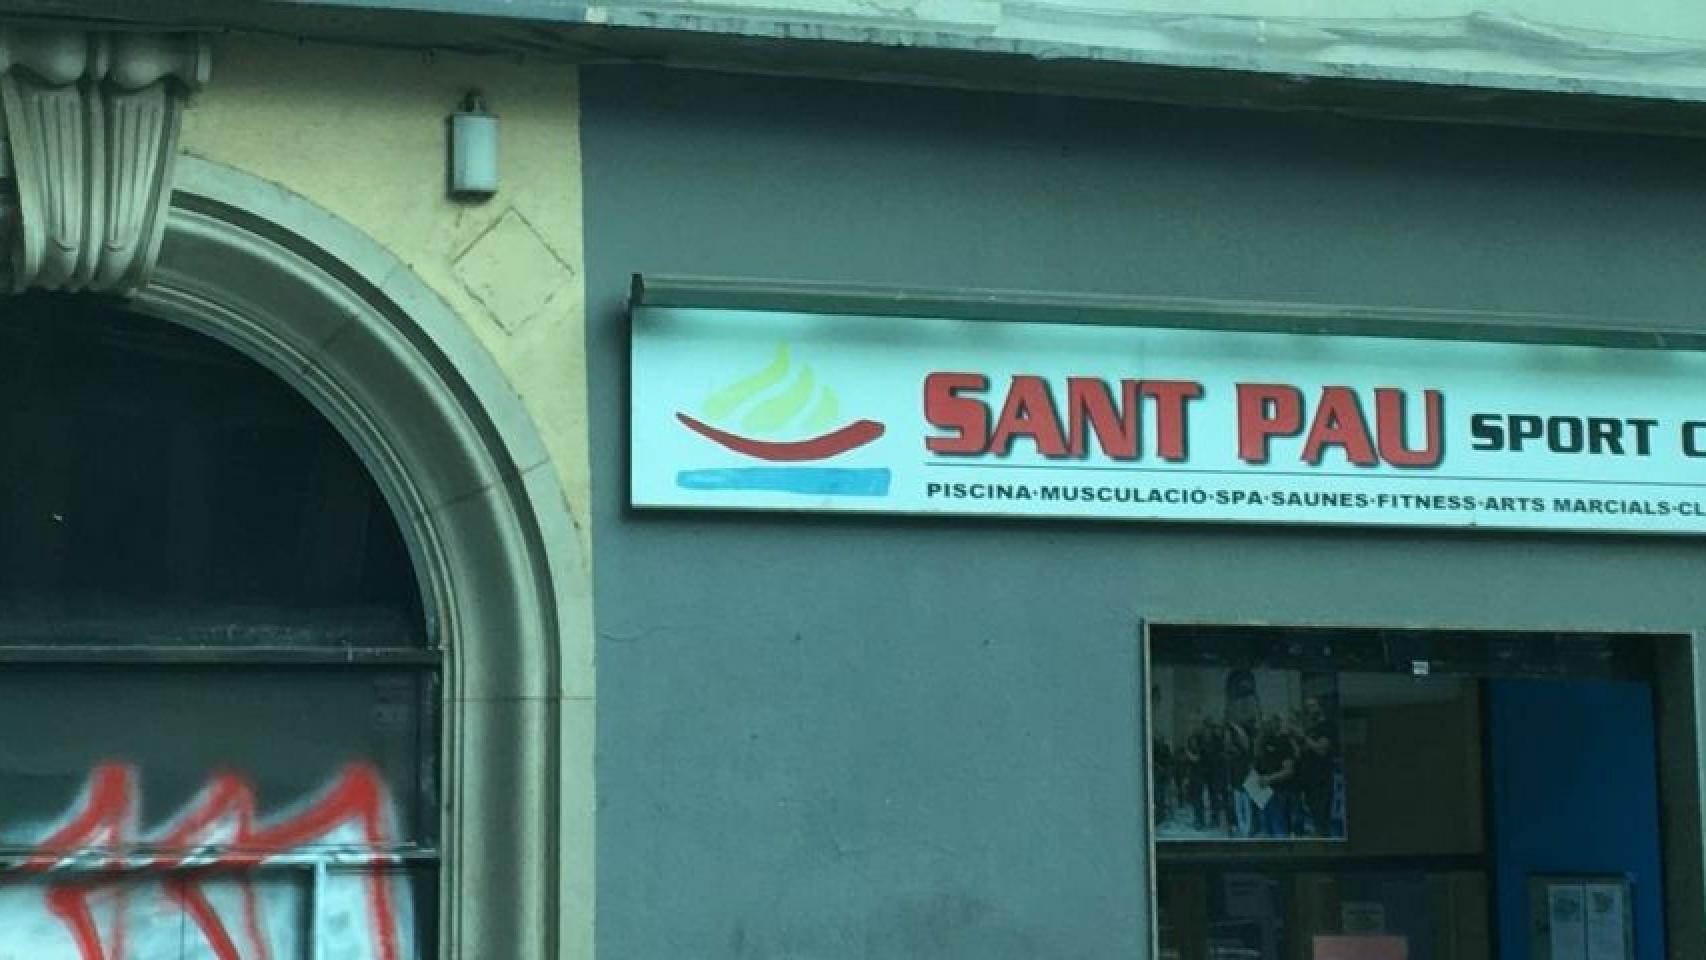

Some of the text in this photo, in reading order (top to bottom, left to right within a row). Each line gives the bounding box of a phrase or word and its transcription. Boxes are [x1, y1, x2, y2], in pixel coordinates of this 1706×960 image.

[923, 371, 1206, 463] SANT
[1235, 382, 1446, 470] PAU
[1470, 413, 1659, 457] SPORT
